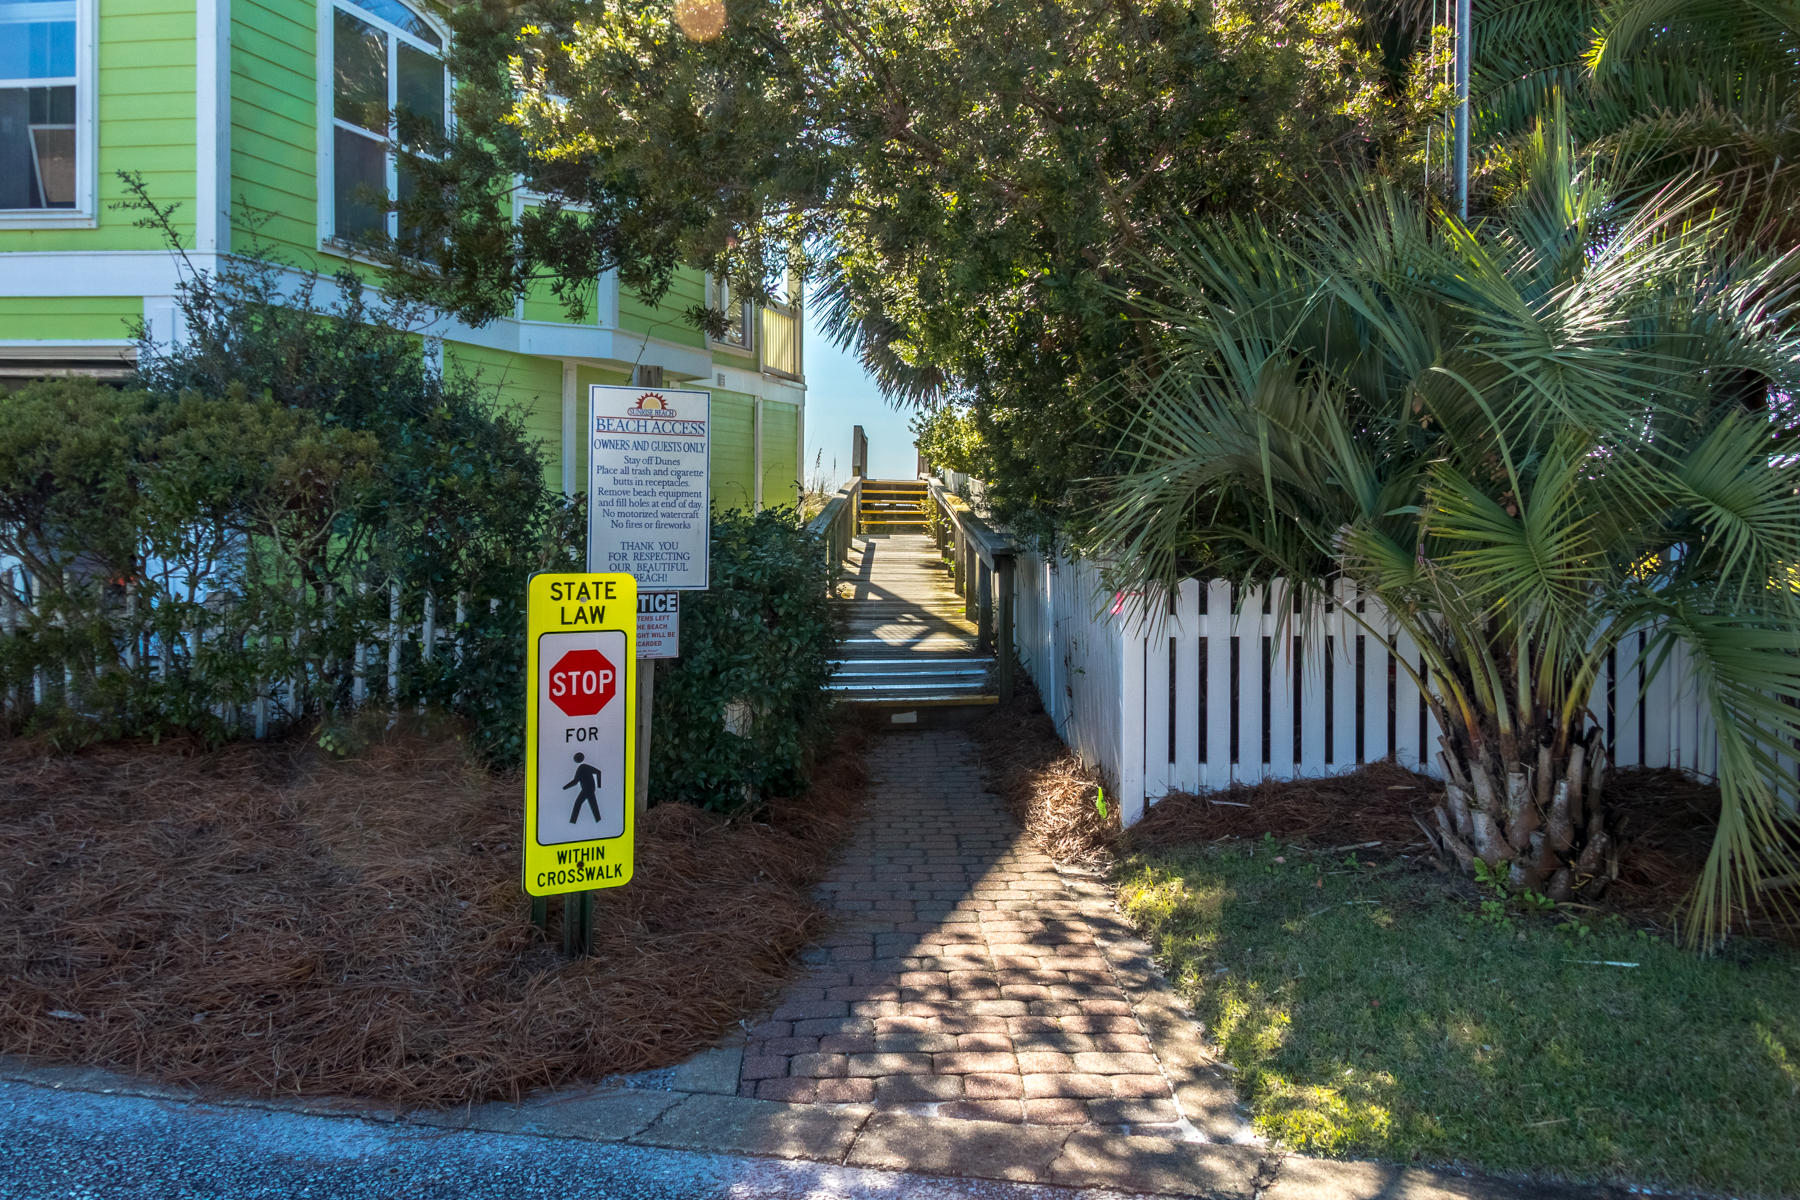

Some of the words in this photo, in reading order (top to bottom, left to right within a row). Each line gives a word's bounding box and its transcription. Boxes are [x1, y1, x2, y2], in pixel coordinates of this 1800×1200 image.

[629, 408, 654, 417] SUNRISE
[654, 409, 674, 418] BEACH
[596, 418, 647, 433] BEACH
[652, 420, 706, 435] ACCESS
[594, 438, 632, 451] OWNERS
[631, 440, 650, 451] AND
[651, 440, 682, 452] GUESTS
[683, 442, 706, 453] ONLY
[624, 455, 641, 467] Stay
[642, 456, 655, 465] off
[655, 457, 681, 466] Dunes
[596, 465, 618, 475] Place
[620, 466, 630, 475] all
[631, 467, 651, 476] trash
[653, 467, 669, 476] and
[670, 468, 704, 479] cigarette
[613, 477, 634, 486] butts
[635, 477, 644, 486] in
[645, 478, 689, 489] receptacles.
[598, 487, 631, 497] Remove
[633, 487, 657, 497] beach
[658, 489, 702, 500] equipment
[598, 498, 615, 507] and
[616, 498, 627, 507] fill
[629, 499, 650, 508] holes
[651, 500, 660, 508] at
[661, 500, 677, 508] end
[678, 500, 688, 508] of
[688, 500, 704, 511] day.
[602, 509, 616, 518] No
[617, 510, 659, 519] motorized
[660, 510, 699, 519] watercraft
[611, 520, 624, 529] No
[625, 520, 643, 529] fires
[655, 520, 692, 529] fireworks
[620, 541, 654, 551] THANK
[658, 541, 679, 551] YOU
[608, 552, 628, 561] FOR
[633, 552, 690, 561] RESPECTING
[609, 563, 632, 572] OUR
[637, 563, 689, 572] BEAUTIFUL
[634, 573, 668, 583] BEACH!
[550, 581, 617, 602] STATE
[636, 594, 677, 612] TICE
[560, 606, 606, 626] LAW
[552, 669, 613, 697] STOP
[565, 727, 599, 743] FOR
[557, 846, 605, 865] WITHIN
[537, 863, 623, 888] CROSSWALK
